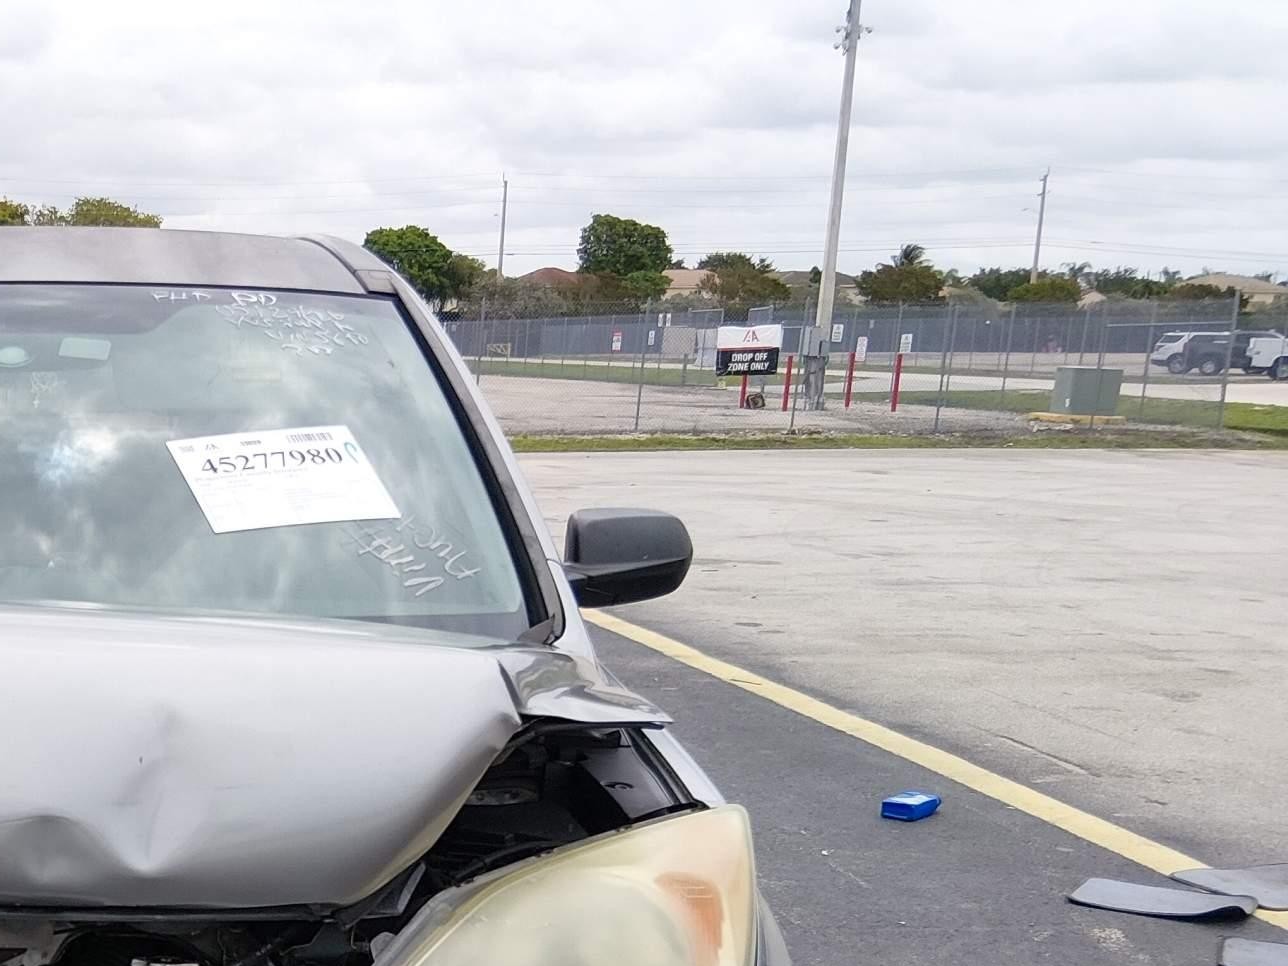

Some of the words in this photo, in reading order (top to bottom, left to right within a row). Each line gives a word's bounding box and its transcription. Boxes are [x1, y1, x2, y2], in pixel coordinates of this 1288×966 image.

[732, 353, 753, 362] DROP
[754, 352, 768, 361] OFF
[727, 362, 749, 371] ZONE
[750, 362, 769, 371] ONLY
[201, 446, 343, 475] 45277980
